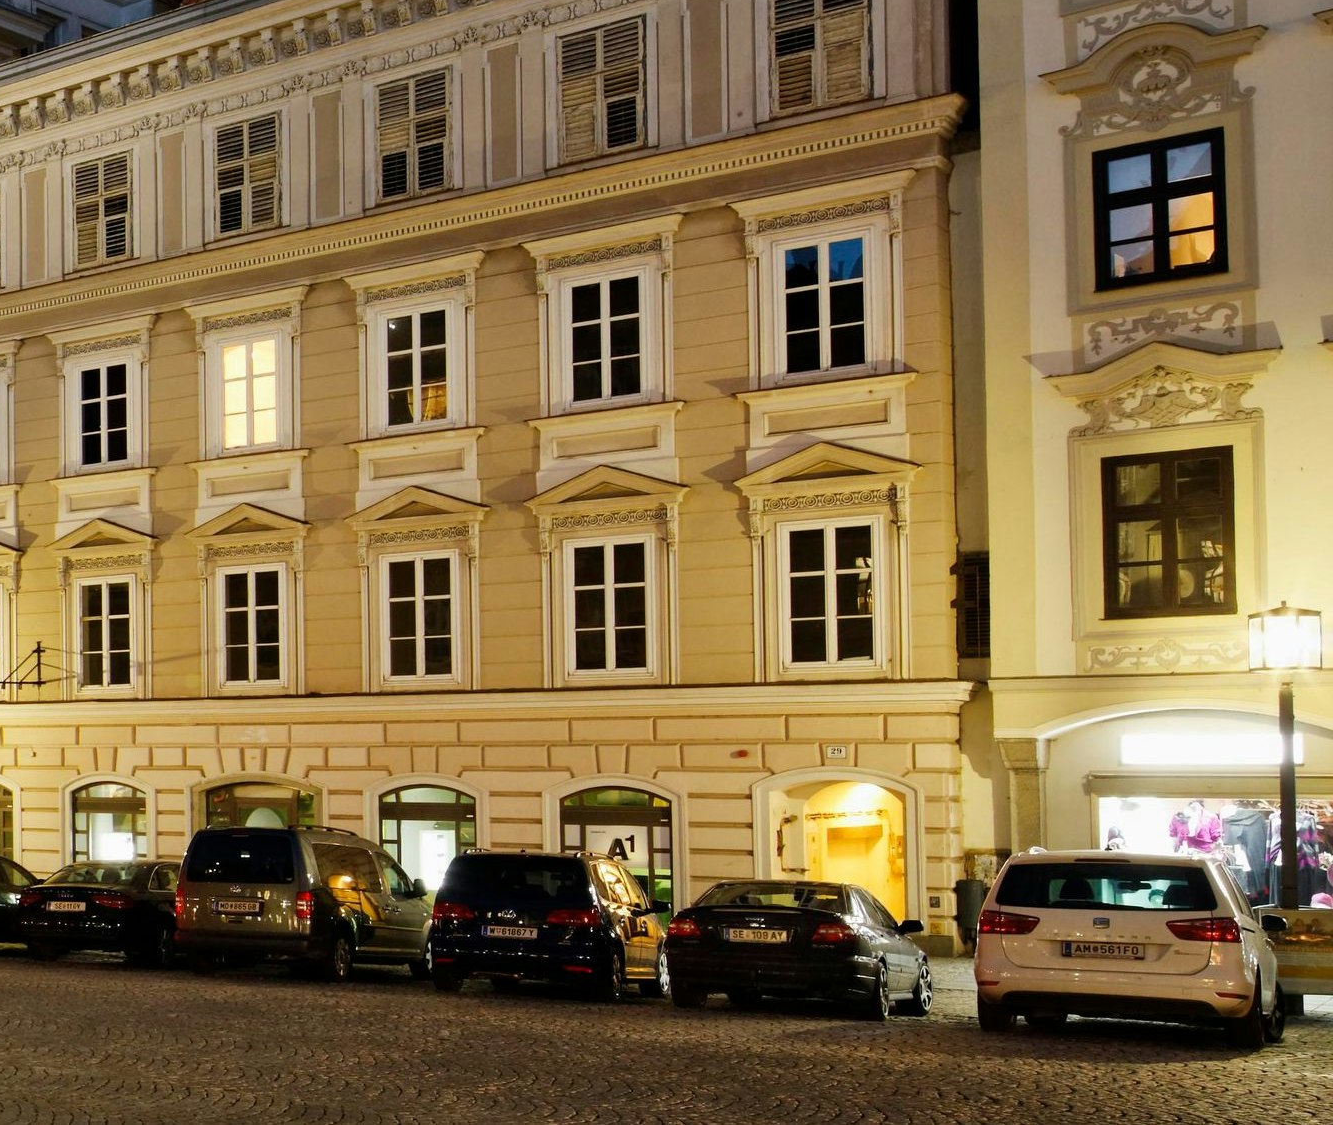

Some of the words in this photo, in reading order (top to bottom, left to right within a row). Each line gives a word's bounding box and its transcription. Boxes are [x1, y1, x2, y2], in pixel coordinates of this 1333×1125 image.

[830, 747, 842, 755] 29
[607, 834, 635, 860] A1
[732, 930, 745, 939] SE
[752, 931, 769, 940] 109
[770, 931, 783, 941] AY
[1074, 945, 1093, 954] AM
